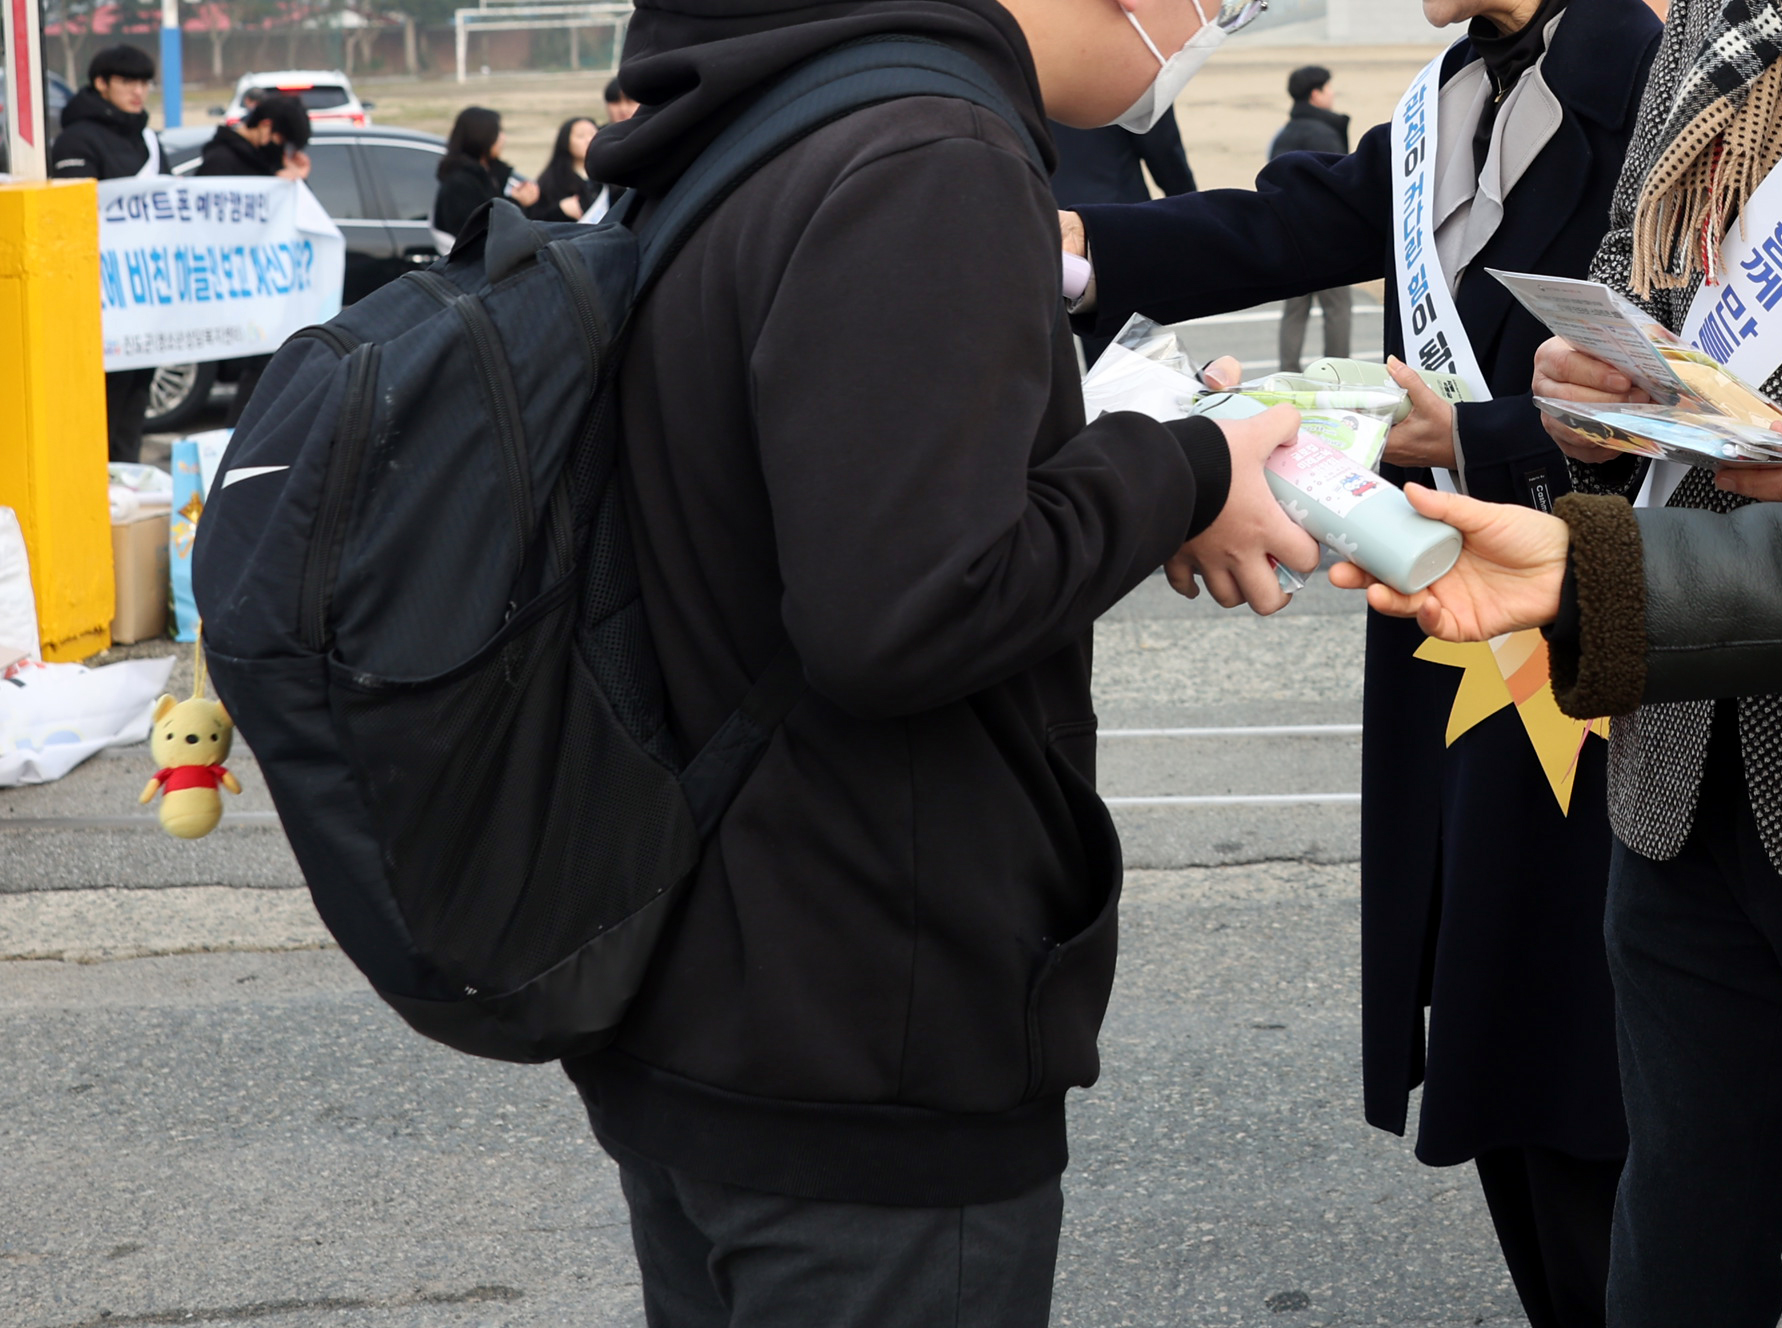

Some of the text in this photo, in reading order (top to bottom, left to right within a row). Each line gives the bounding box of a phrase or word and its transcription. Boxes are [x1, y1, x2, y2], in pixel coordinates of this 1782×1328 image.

[1402, 83, 1427, 178] 관심이
[1403, 170, 1425, 271] 커다란
[125, 245, 173, 306] 비친
[1407, 263, 1438, 337] 힘이
[1418, 330, 1457, 375] 됩
[1691, 283, 1760, 364] 만들
